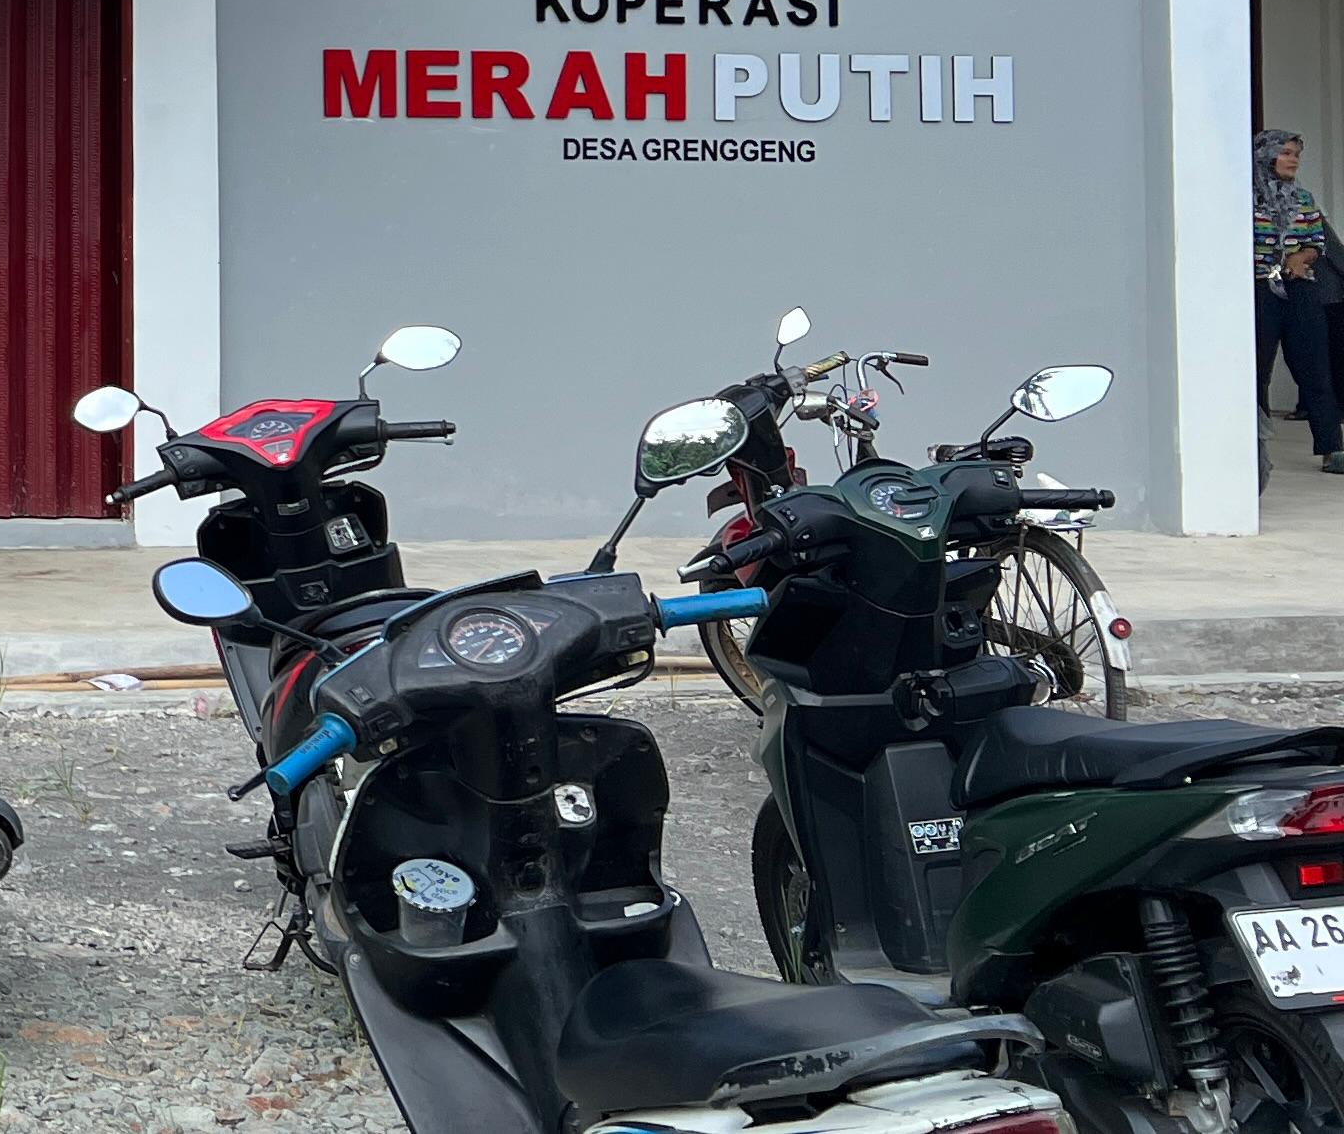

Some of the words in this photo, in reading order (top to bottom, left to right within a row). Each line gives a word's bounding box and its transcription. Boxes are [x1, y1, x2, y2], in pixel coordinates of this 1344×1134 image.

[322, 48, 687, 120] MERAH
[713, 53, 1014, 123] PUTIH
[562, 138, 637, 162] DESA
[642, 138, 817, 164] GRENGGENG
[1252, 919, 1301, 958] AA
